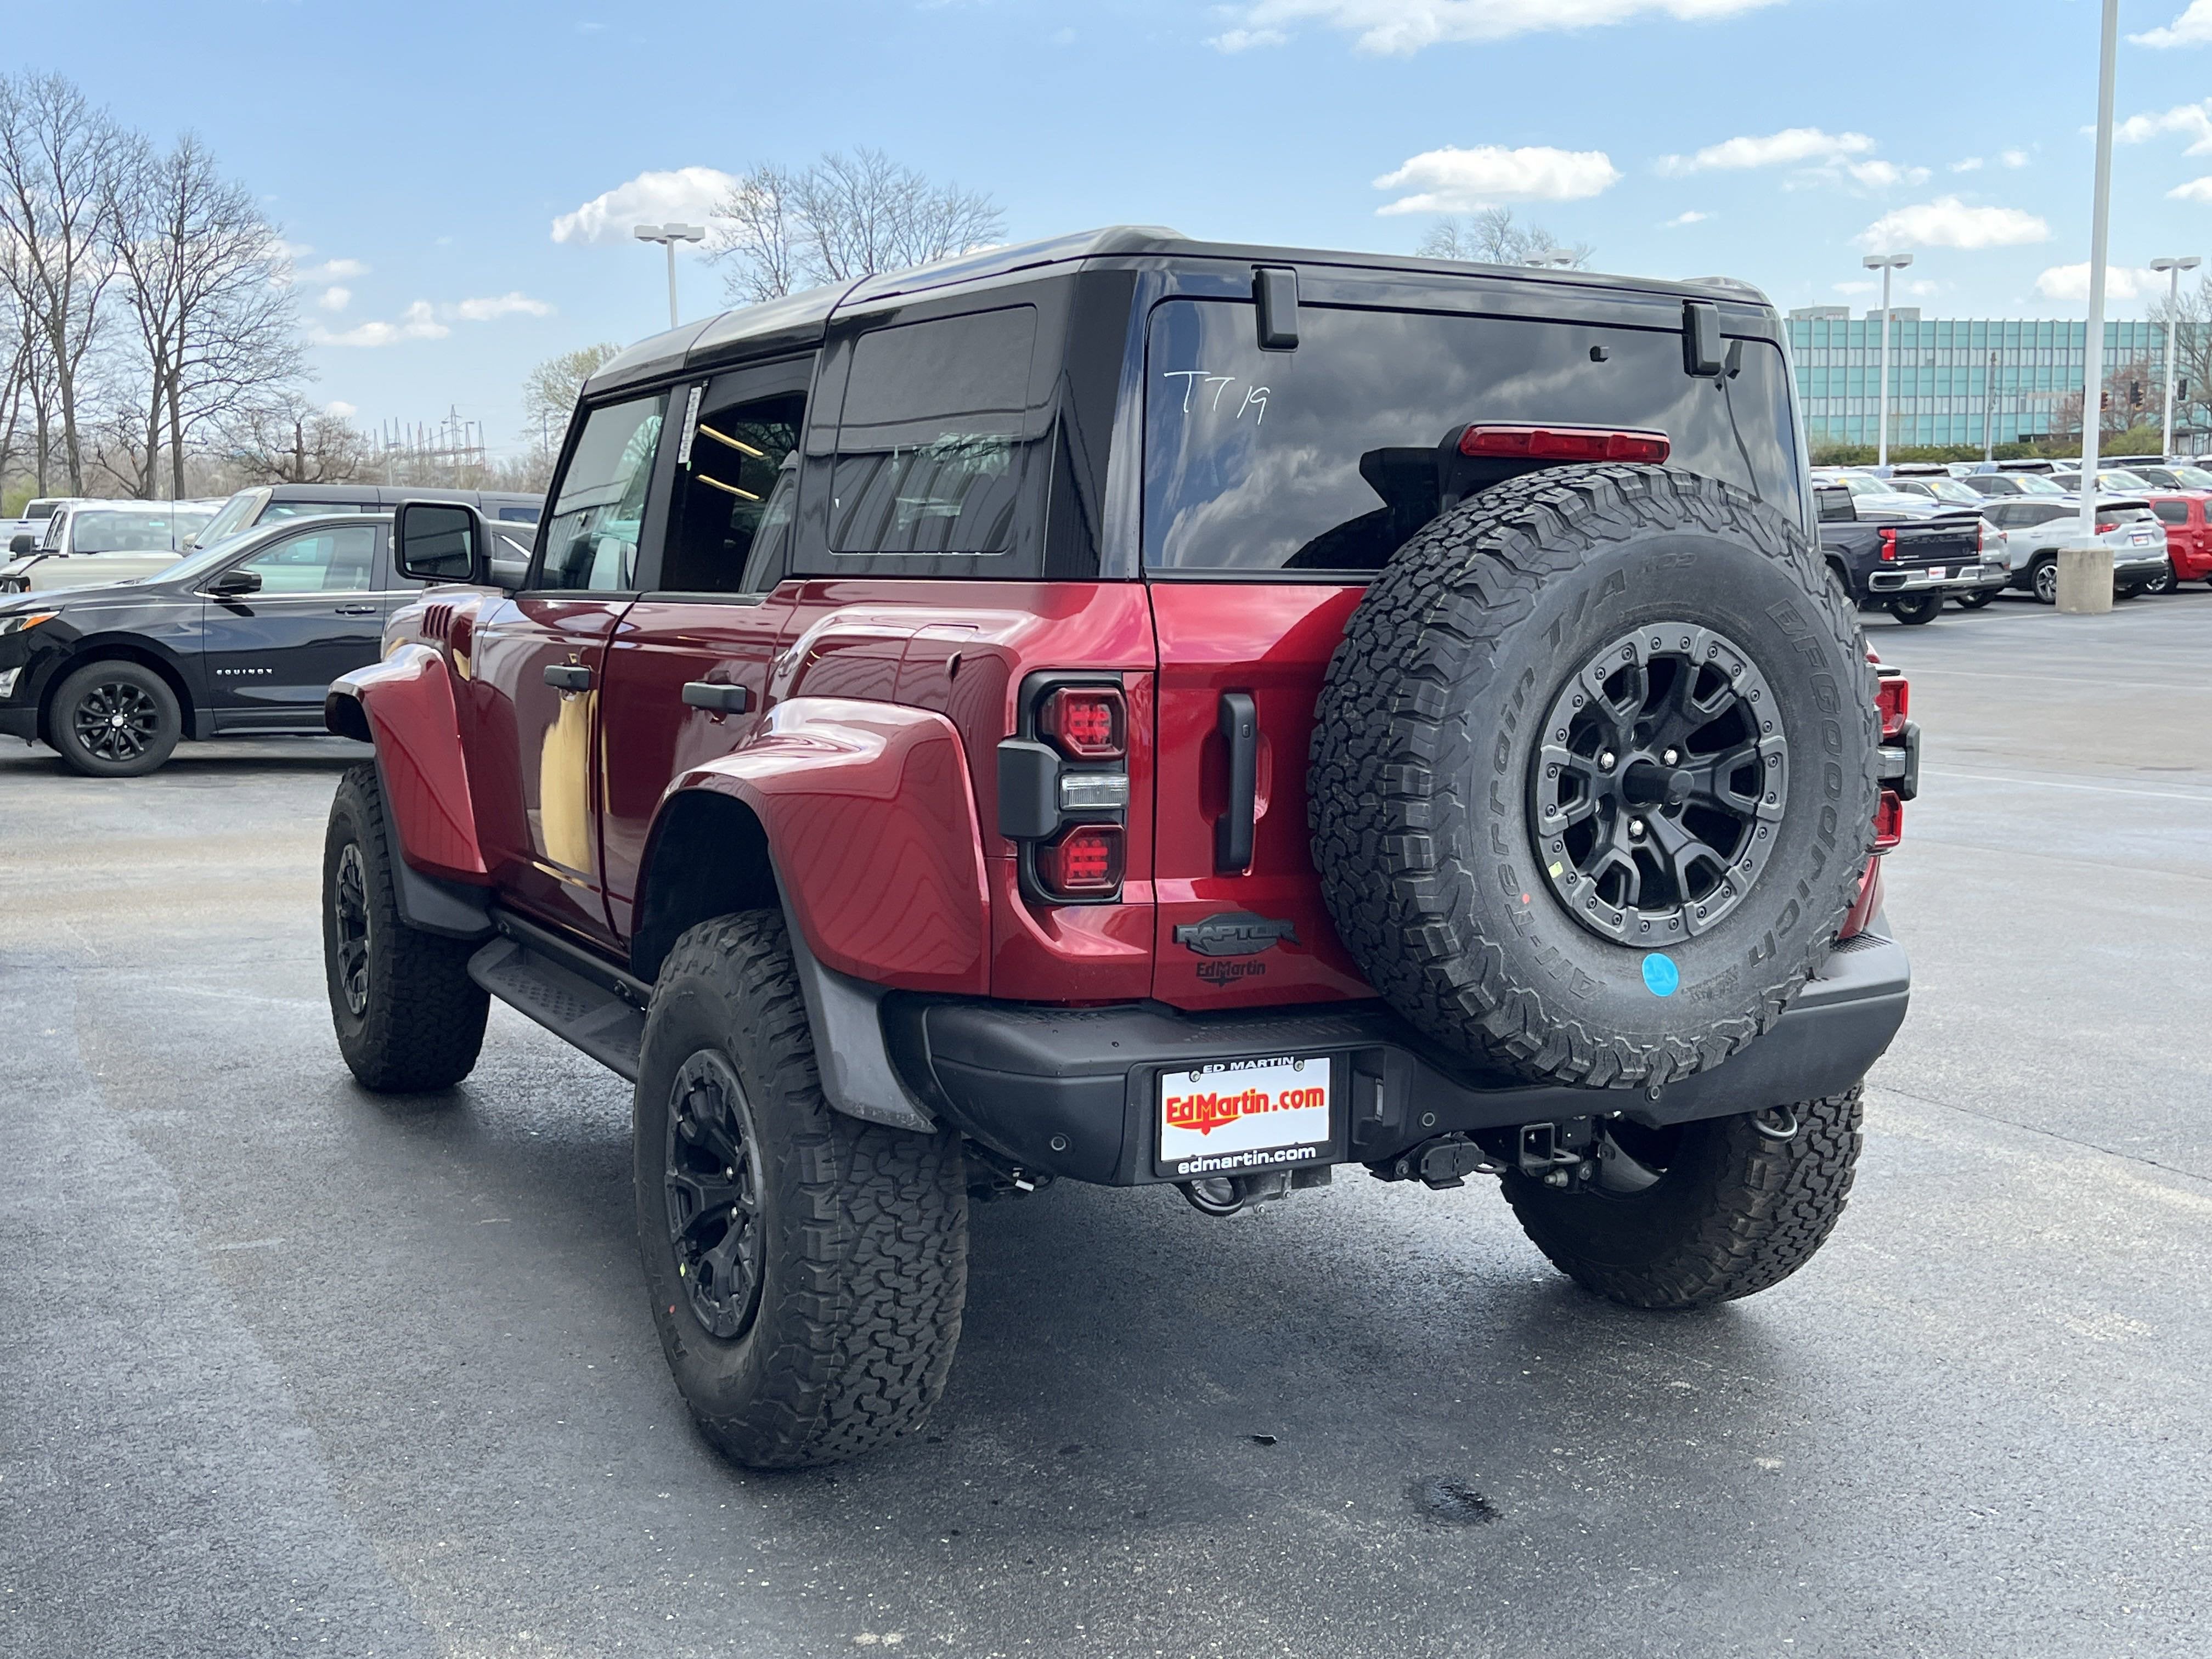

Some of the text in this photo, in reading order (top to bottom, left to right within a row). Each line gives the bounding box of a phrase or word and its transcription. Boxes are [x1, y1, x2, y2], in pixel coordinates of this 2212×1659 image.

[1173, 920, 1302, 952] RAPTOR
[1196, 961, 1266, 979] EdMartin
[1203, 1056, 1295, 1074] ED MARTIN
[1166, 1088, 1325, 1127] EdMartin.com
[1177, 1146, 1316, 1175] edmartin.com
